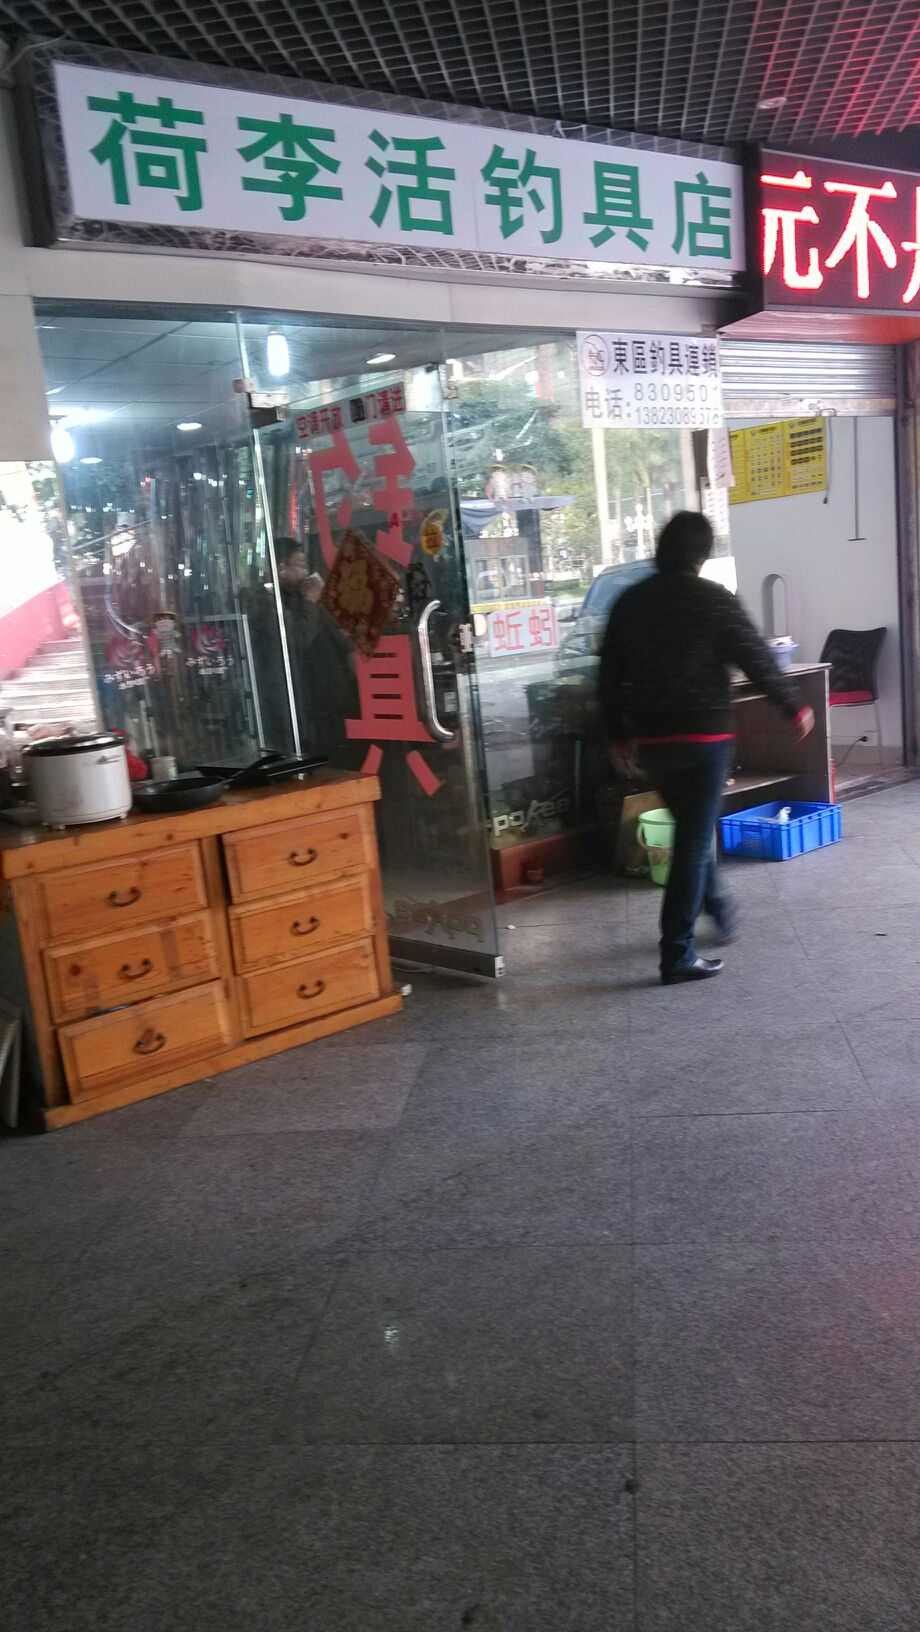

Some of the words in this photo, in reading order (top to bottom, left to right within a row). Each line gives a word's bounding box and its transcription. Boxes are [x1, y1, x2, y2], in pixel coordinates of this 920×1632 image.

[88, 91, 733, 259] 荷李活钓具店
[494, 609, 556, 650] 蚯蚓
